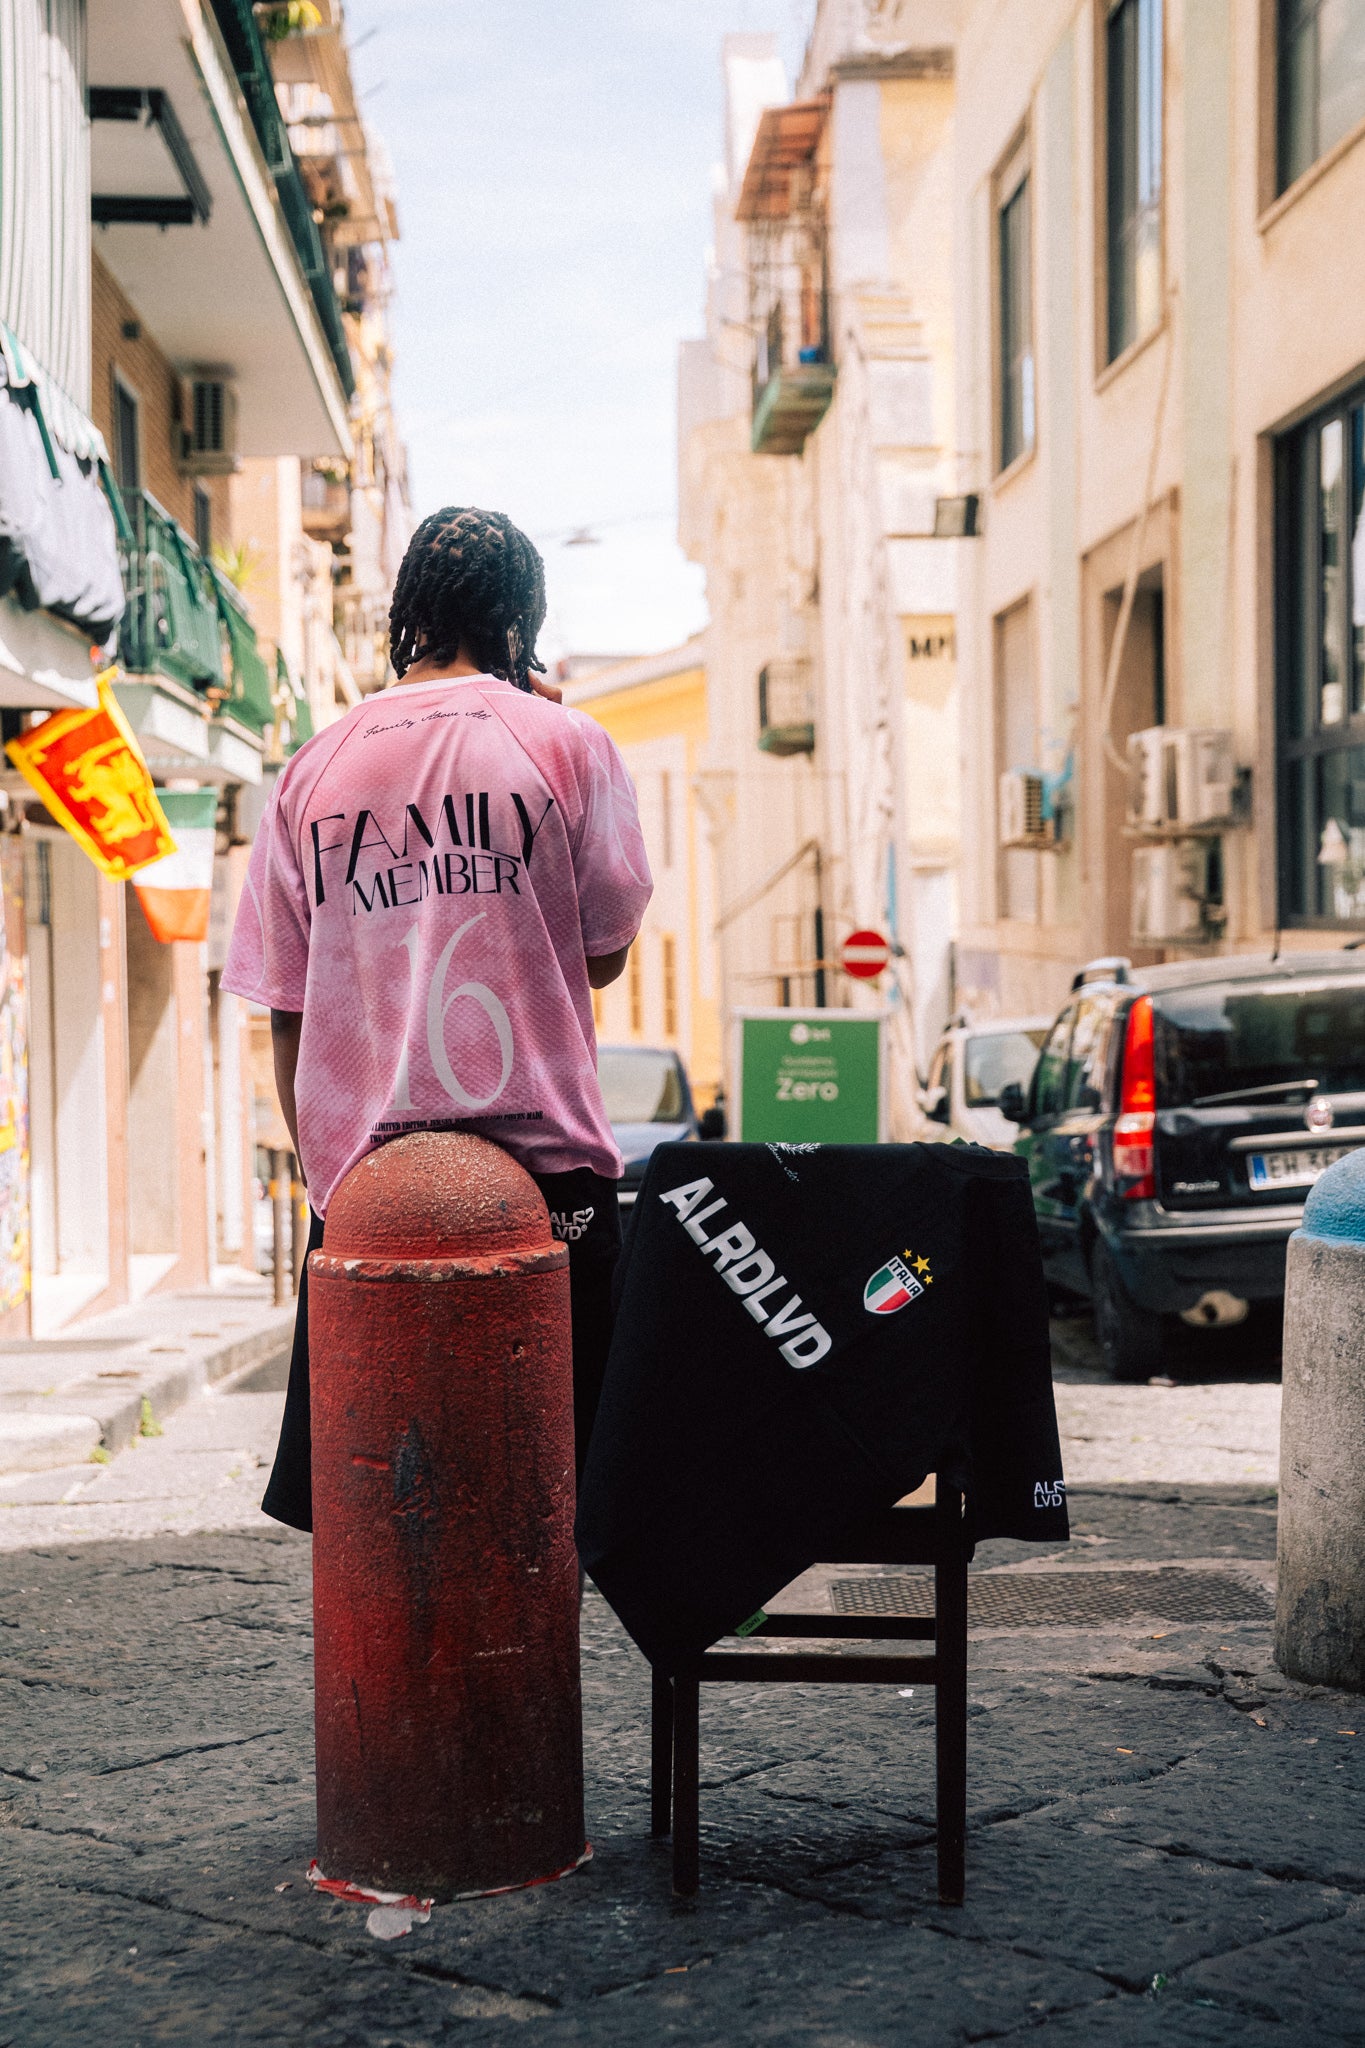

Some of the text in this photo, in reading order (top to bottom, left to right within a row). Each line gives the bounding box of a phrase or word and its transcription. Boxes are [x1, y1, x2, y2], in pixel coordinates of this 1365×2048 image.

[310, 792, 555, 907] FAMILY
[352, 854, 521, 915] MEMBER
[386, 911, 514, 1110] 16
[776, 1077, 839, 1101] Zero
[659, 1176, 833, 1369] ALRDLVD
[888, 1258, 921, 1297] ITALIA
[1034, 1494, 1063, 1508] LVD
